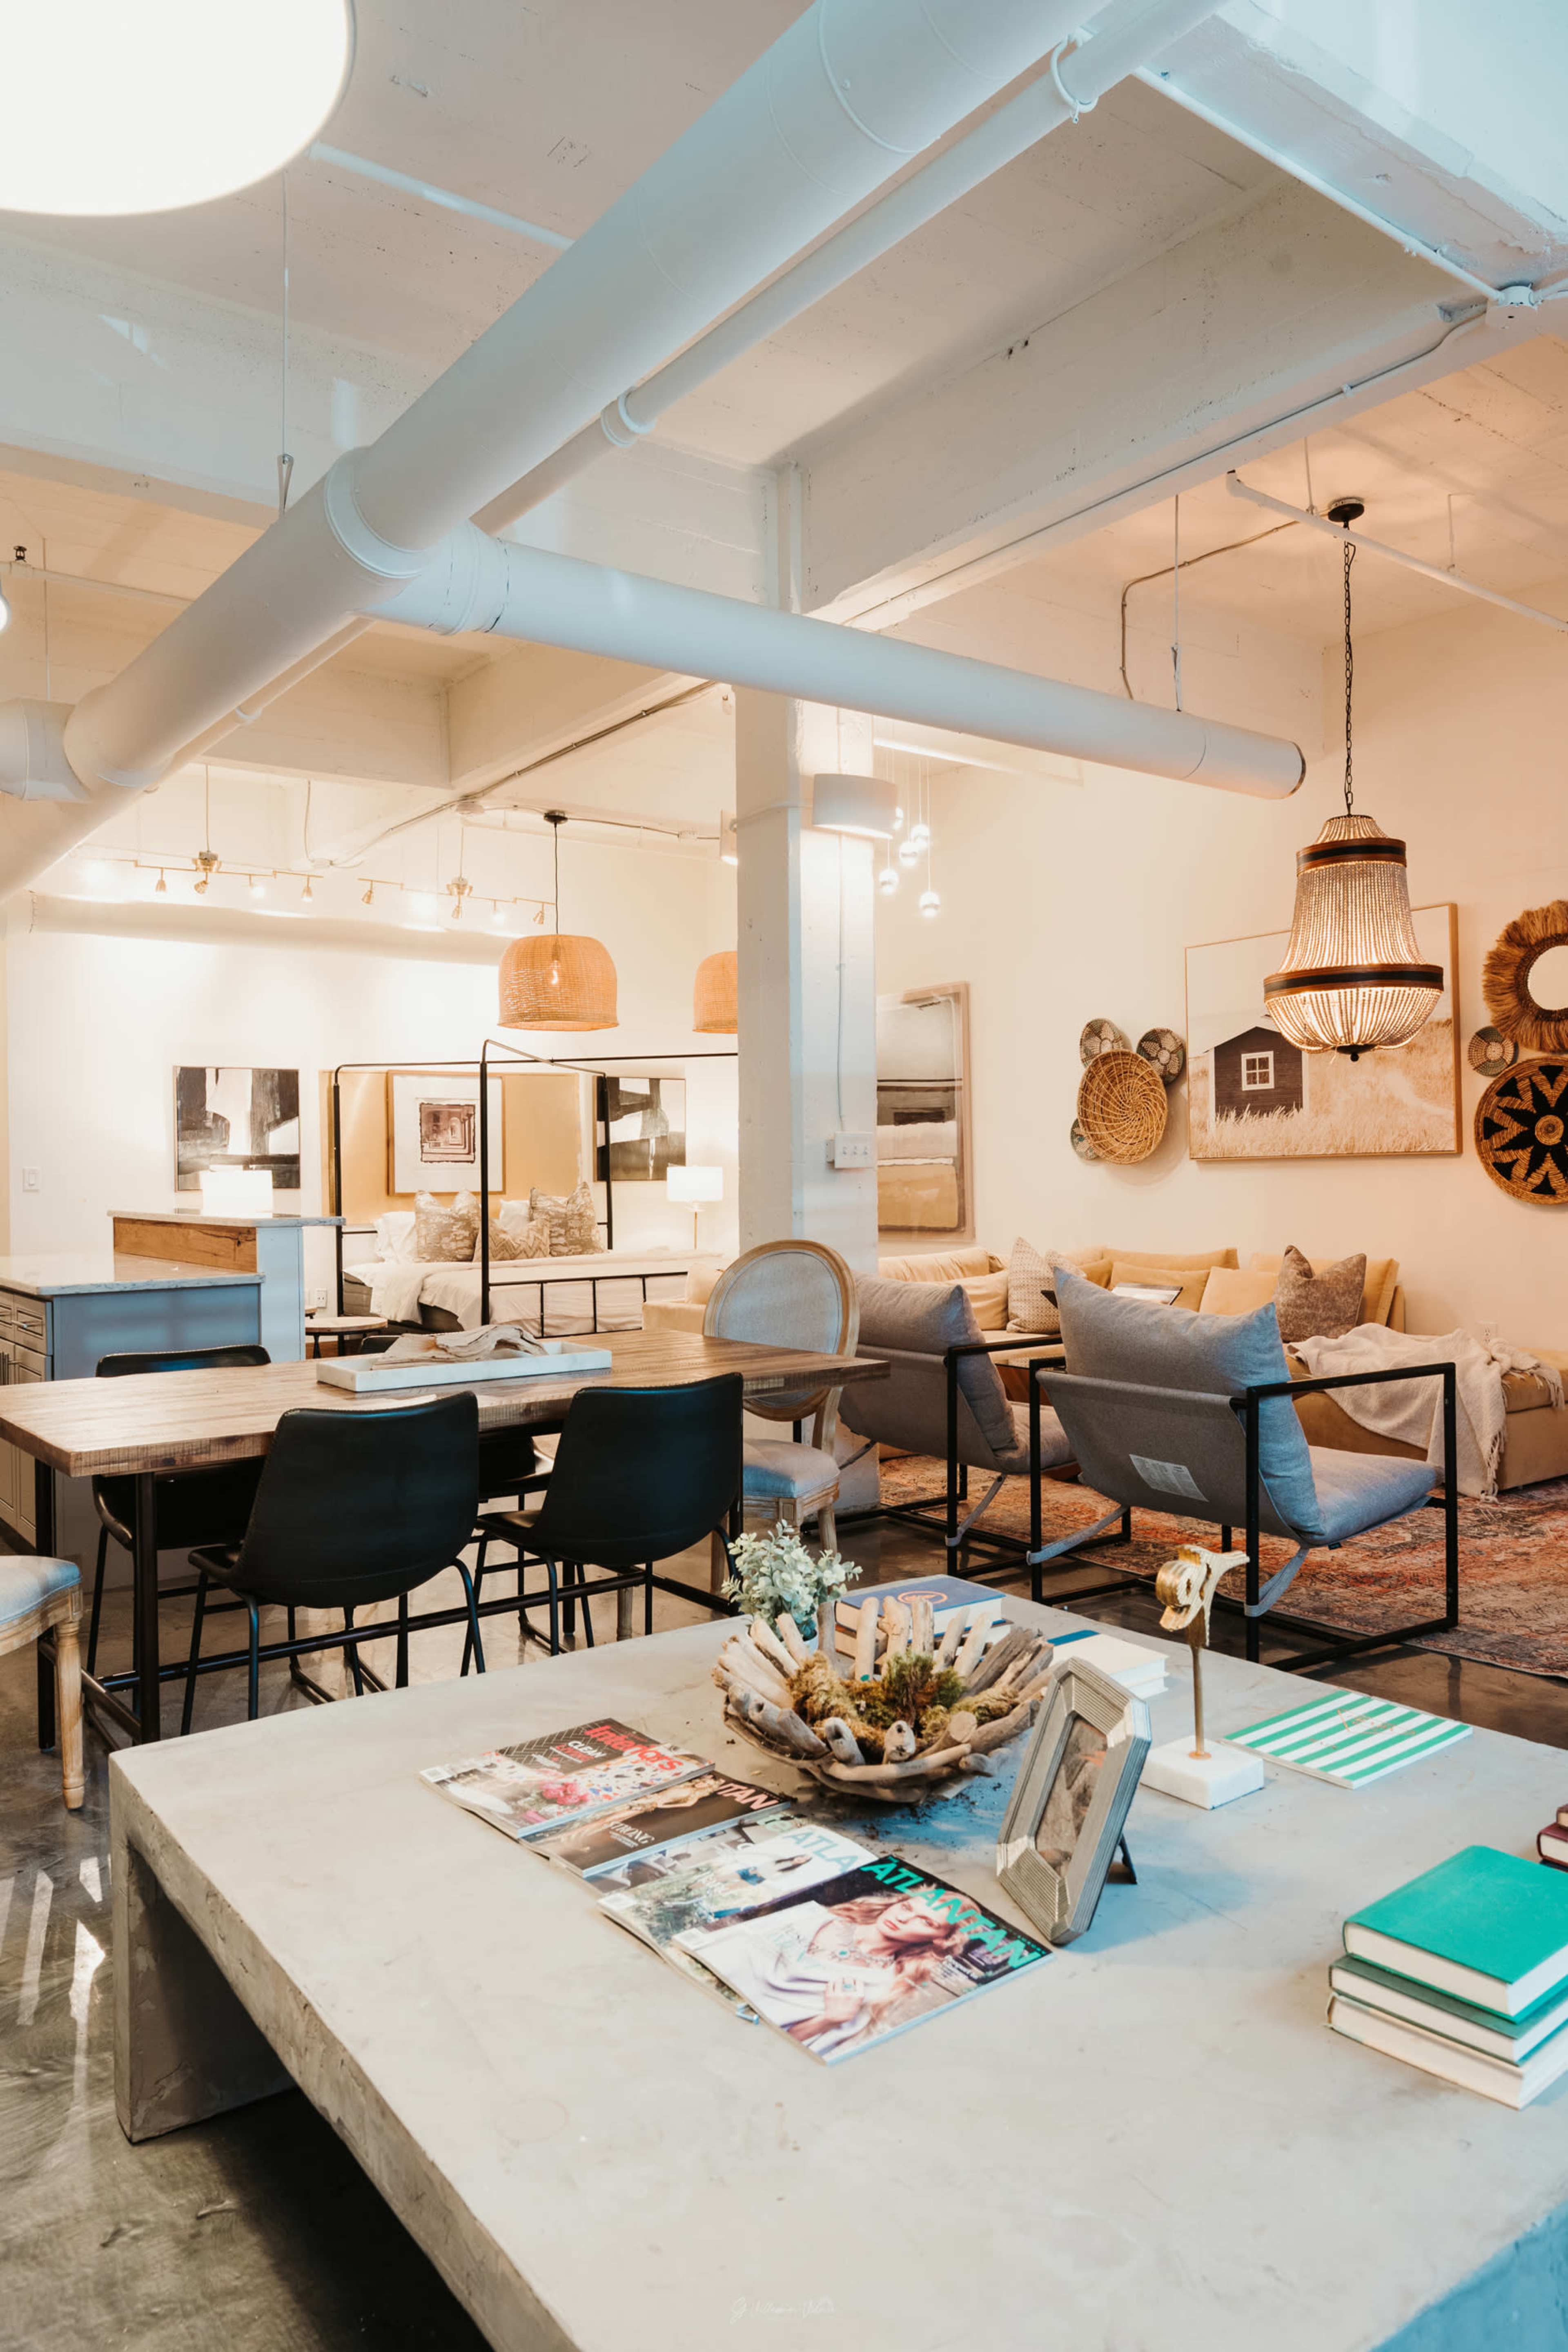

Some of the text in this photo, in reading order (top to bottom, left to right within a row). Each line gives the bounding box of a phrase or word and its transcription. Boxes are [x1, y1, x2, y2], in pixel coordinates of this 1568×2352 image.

[568, 1740, 607, 1758] CLEAN
[584, 1725, 684, 1770] Interiors
[782, 1831, 858, 1873] ATLA
[859, 1862, 1042, 1969] ATLANTAN
